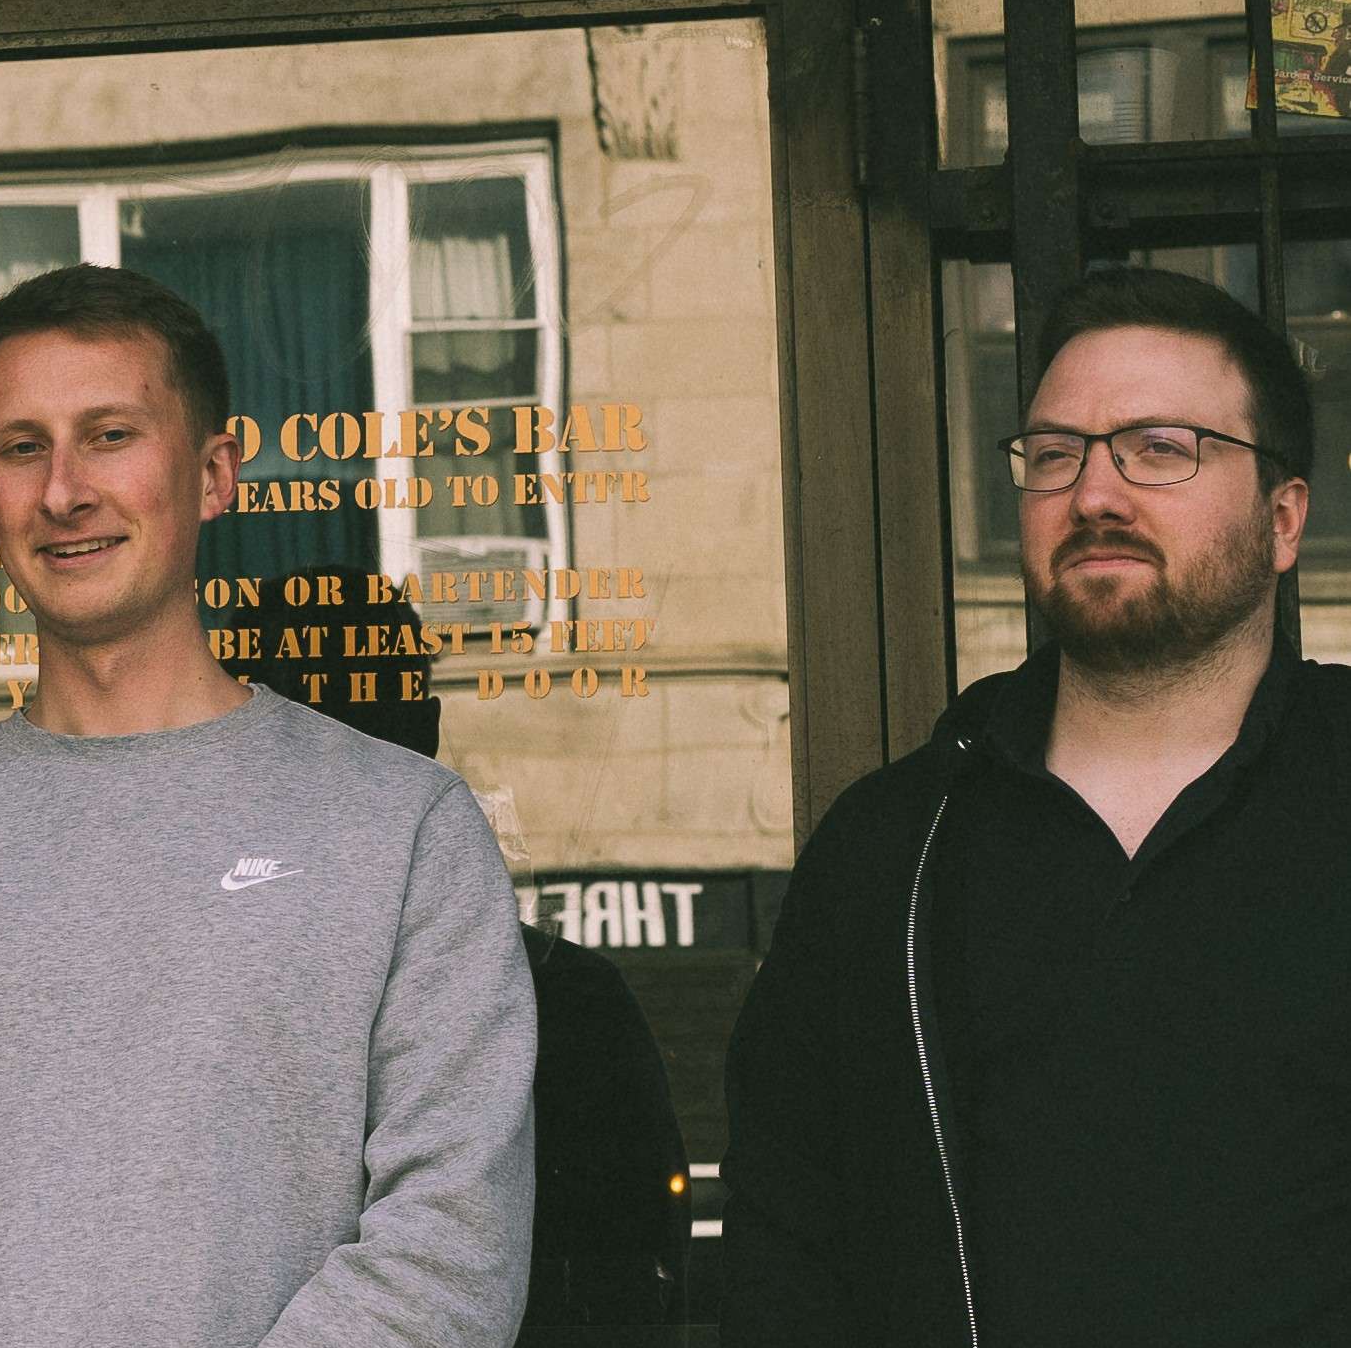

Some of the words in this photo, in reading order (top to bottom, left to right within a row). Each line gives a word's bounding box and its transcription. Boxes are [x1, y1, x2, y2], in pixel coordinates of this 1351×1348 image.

[1313, 72, 1351, 84] Servic
[225, 415, 262, 464] O
[280, 406, 492, 462] COLE'S
[512, 404, 649, 454] BAR
[223, 479, 341, 513] EARS
[355, 478, 433, 509] OLD
[446, 475, 500, 507] TO
[194, 578, 260, 609] ON
[284, 576, 344, 606] OR
[367, 567, 646, 604] BARTENDER
[207, 628, 261, 660] BE
[275, 626, 328, 659] AT
[343, 622, 474, 657] LEAST
[489, 620, 534, 655] 15
[549, 619, 657, 653] FEET
[302, 670, 423, 703] THE
[477, 667, 650, 700] DOOR
[233, 858, 283, 877] NIKE
